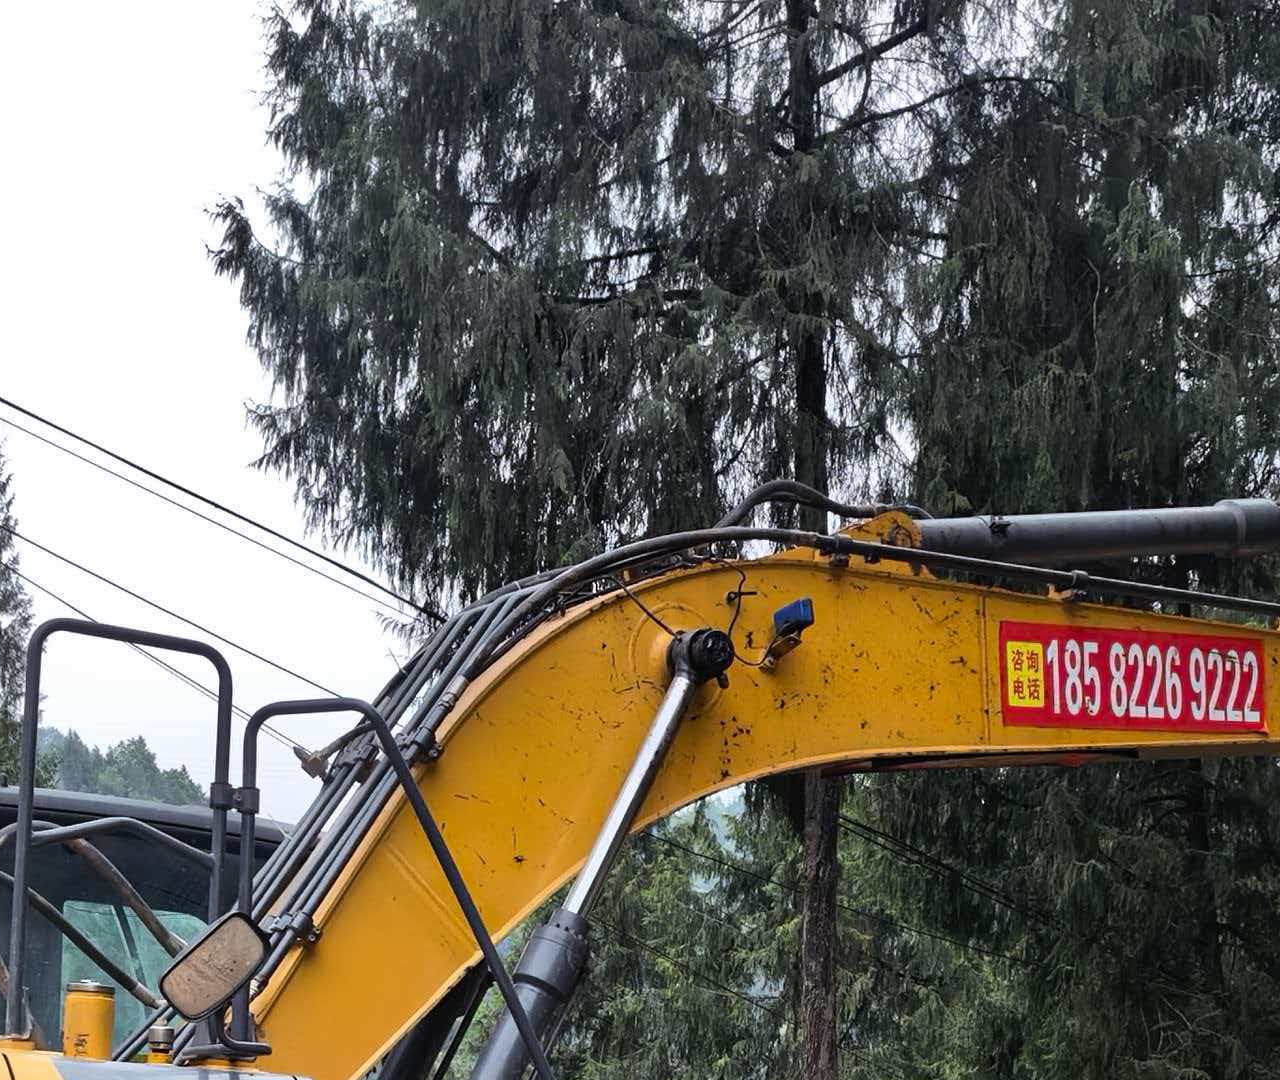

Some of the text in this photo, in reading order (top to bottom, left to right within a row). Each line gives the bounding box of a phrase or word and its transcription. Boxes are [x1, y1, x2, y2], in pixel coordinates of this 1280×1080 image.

[1012, 649, 1039, 673] 咨询
[1013, 677, 1040, 700] 电话
[1047, 639, 1260, 722] 185 8226 9222
